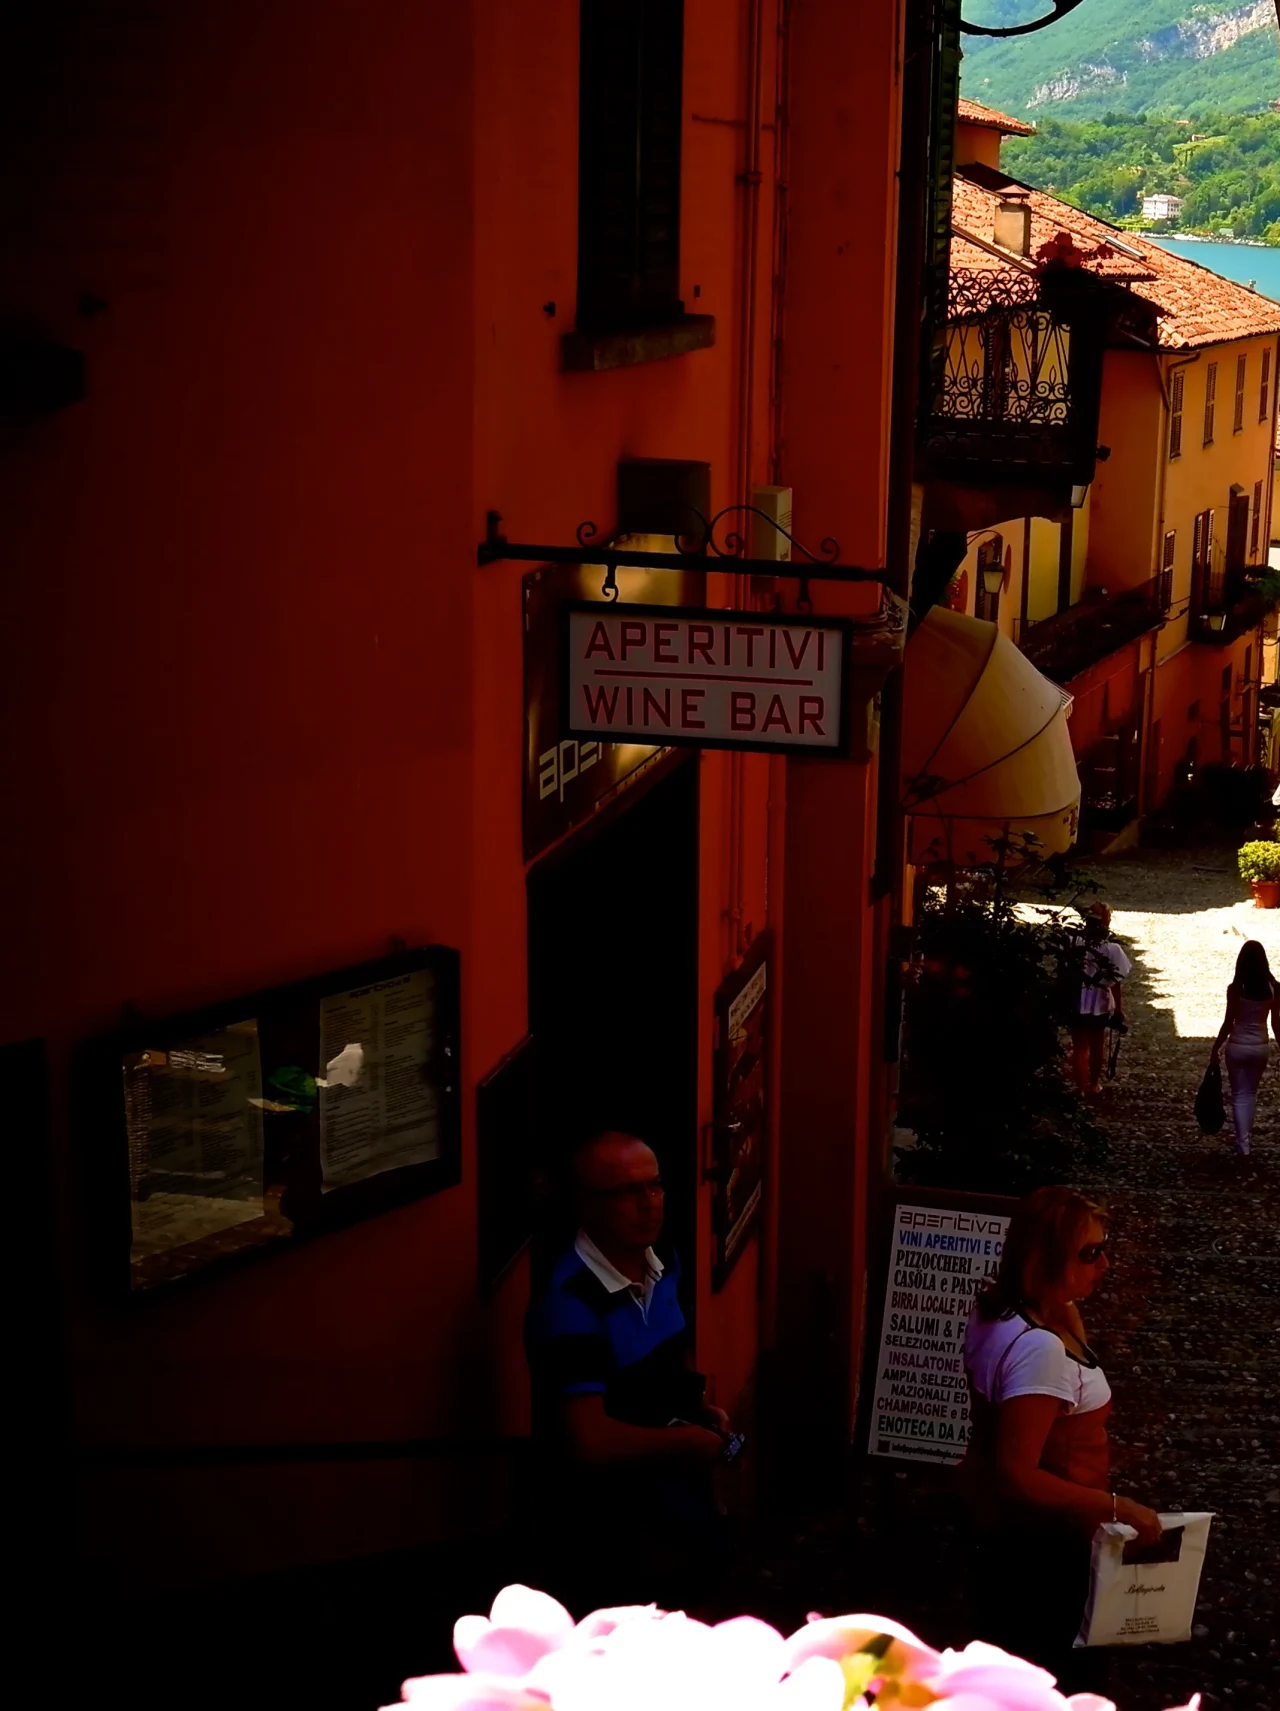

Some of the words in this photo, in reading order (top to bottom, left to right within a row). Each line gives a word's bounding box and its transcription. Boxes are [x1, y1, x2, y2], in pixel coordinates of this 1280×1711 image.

[584, 620, 824, 671] APERITIVI
[583, 684, 706, 729] WINE
[730, 691, 826, 736] BAR
[899, 1211, 1001, 1235] aperitivo
[899, 1230, 922, 1247] VINI
[925, 1233, 981, 1254] APERITIVI
[983, 1240, 992, 1256] E
[895, 1249, 973, 1275] PIZZOCCHERI
[894, 1269, 936, 1291] CASÖLA
[940, 1277, 948, 1293] e
[891, 1290, 918, 1311] BIRRA
[920, 1294, 956, 1316] LOCALE
[890, 1313, 940, 1337] SALUMI
[943, 1320, 953, 1338] &
[884, 1334, 957, 1354] SELEZIONATI
[888, 1351, 961, 1373] INSALATONE
[882, 1368, 917, 1384] AMPIA
[890, 1383, 951, 1402] NAZIONALI
[953, 1391, 968, 1404] ED
[877, 1397, 948, 1418] CHAMPAGNE
[950, 1408, 958, 1419] e
[960, 1407, 971, 1420] B
[877, 1414, 935, 1438] ENOTECA
[938, 1422, 954, 1441] DA
